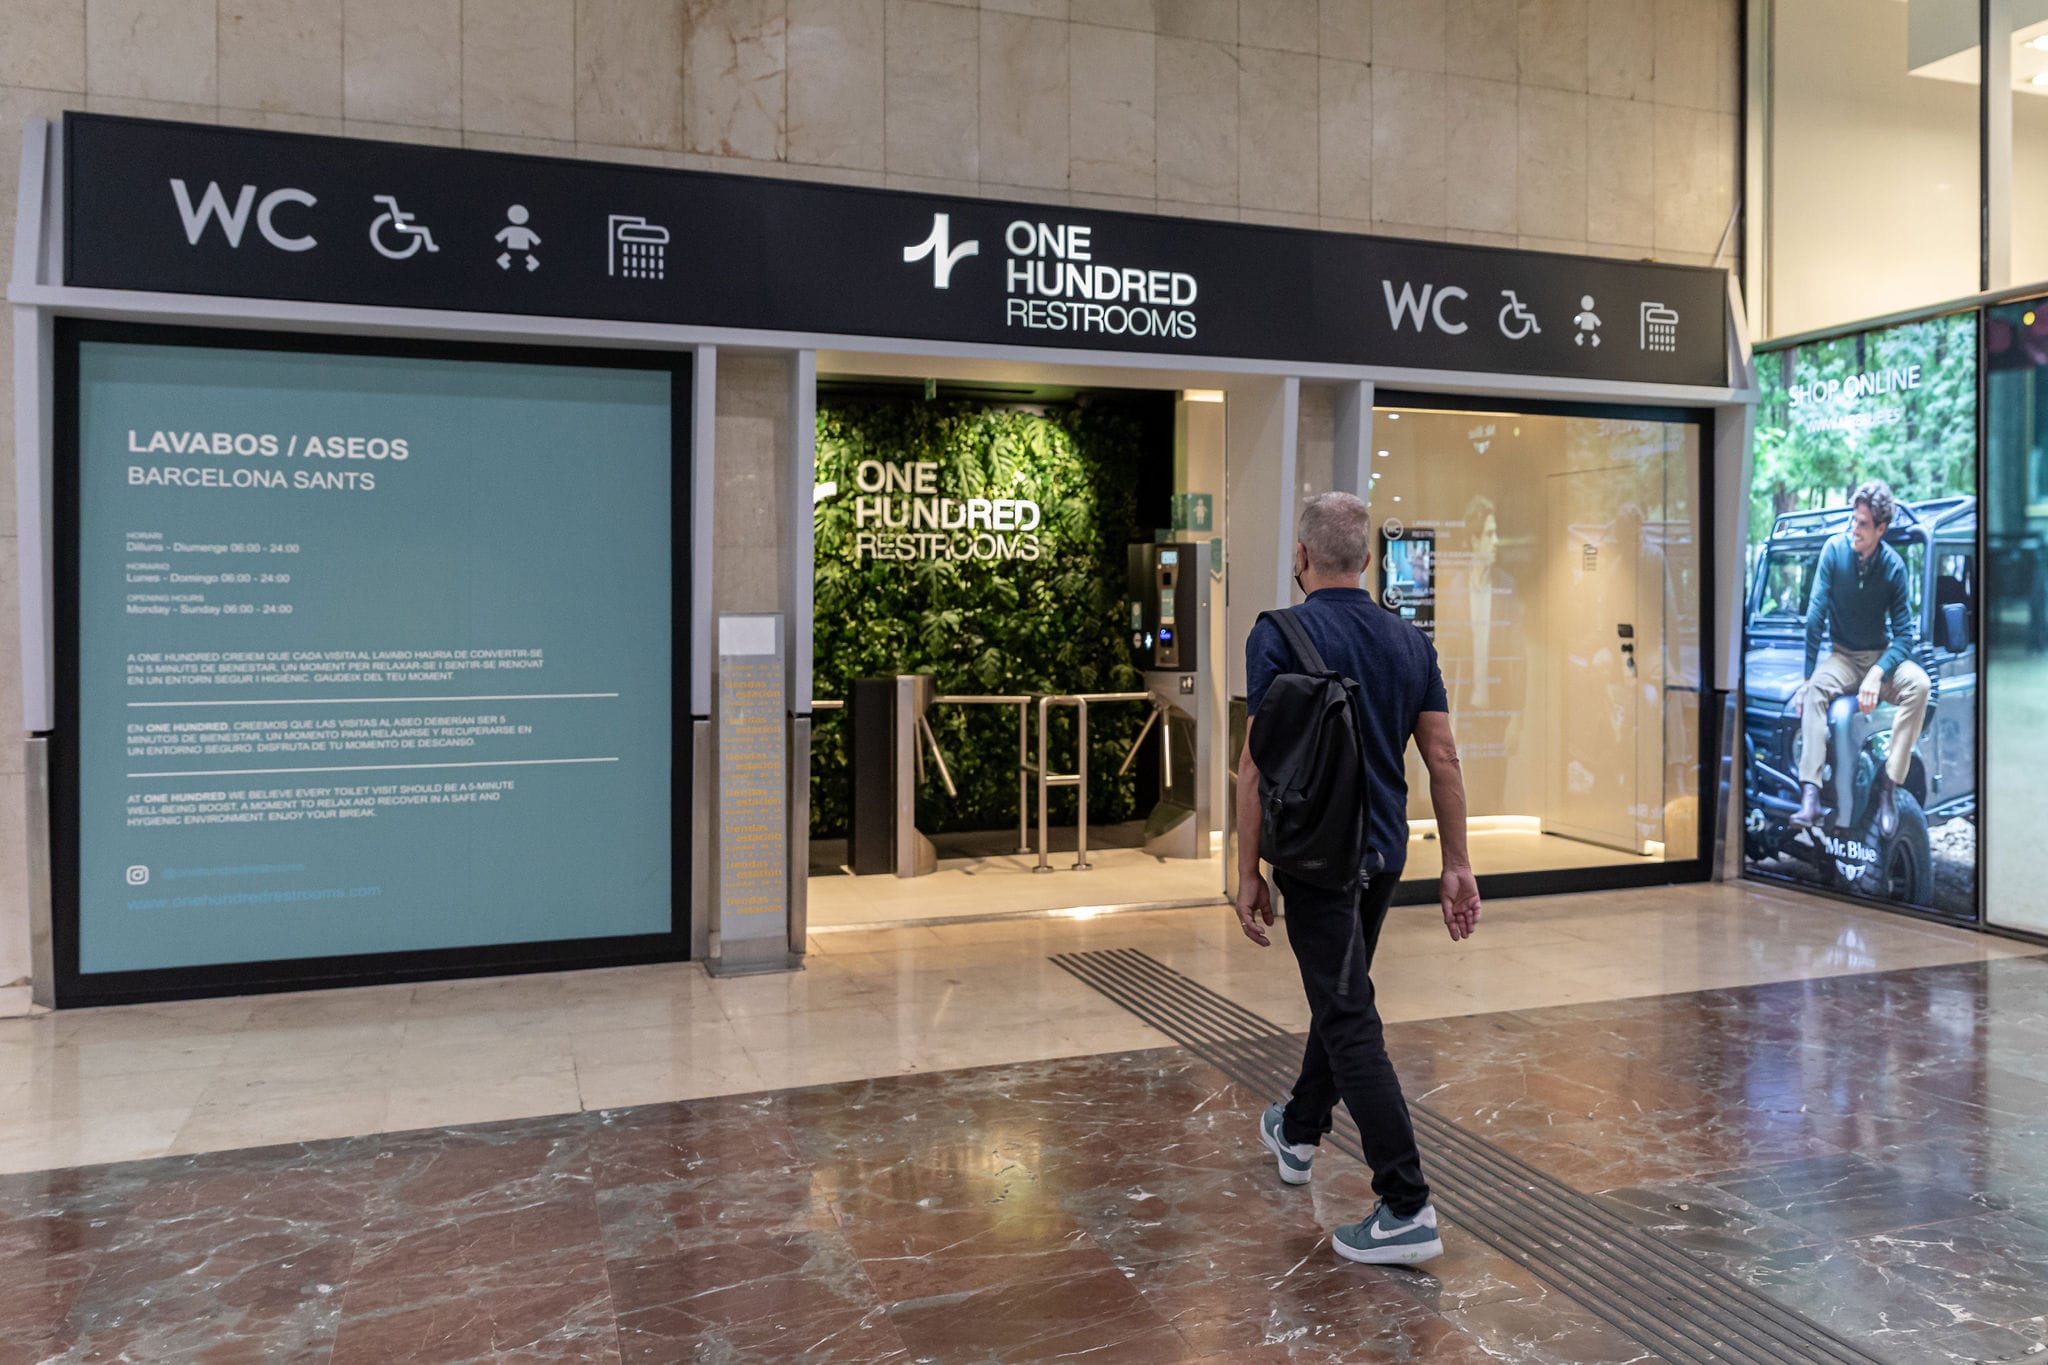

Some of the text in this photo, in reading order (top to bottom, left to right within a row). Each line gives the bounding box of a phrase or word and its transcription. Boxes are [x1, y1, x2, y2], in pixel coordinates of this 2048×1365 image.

[170, 178, 318, 252] WC
[1005, 220, 1092, 261] ONE
[1006, 258, 1198, 306] HUNDRED
[1006, 299, 1197, 339] RESTROOMS
[1382, 280, 1469, 335] WC
[1788, 364, 1921, 408] SHOP ONLINE
[128, 430, 409, 461] LAVABOS / ASEOS
[128, 466, 375, 491] BARCELONA SANTS
[856, 460, 939, 494] ONE
[856, 496, 1040, 532] HUNDRED
[126, 542, 163, 552] Dilluns
[173, 542, 228, 554] Diumenge
[230, 543, 260, 553] 06:00
[269, 544, 300, 553] 24:00
[856, 534, 1040, 560] RESTROOMS
[126, 573, 161, 583] Lunes
[170, 574, 218, 585] Domingo
[220, 574, 251, 583] 06:00
[260, 574, 291, 583] 24:00
[126, 605, 170, 616] Monday
[180, 605, 221, 616] Sunday
[223, 605, 254, 614] 06:00
[263, 605, 293, 614] 24:00
[165, 653, 220, 661] HUNDRED
[201, 664, 215, 672] DE
[146, 724, 170, 732] ONE
[290, 721, 313, 729] QUE
[181, 734, 196, 743] DE
[312, 742, 326, 751] DE
[401, 740, 415, 748] DE
[144, 794, 168, 803] ONE
[171, 792, 226, 802] HUNDRED
[301, 800, 314, 808] TO
[353, 797, 376, 806] AND
[479, 793, 500, 802] AND
[1825, 836, 1877, 862] Mr. Blue
